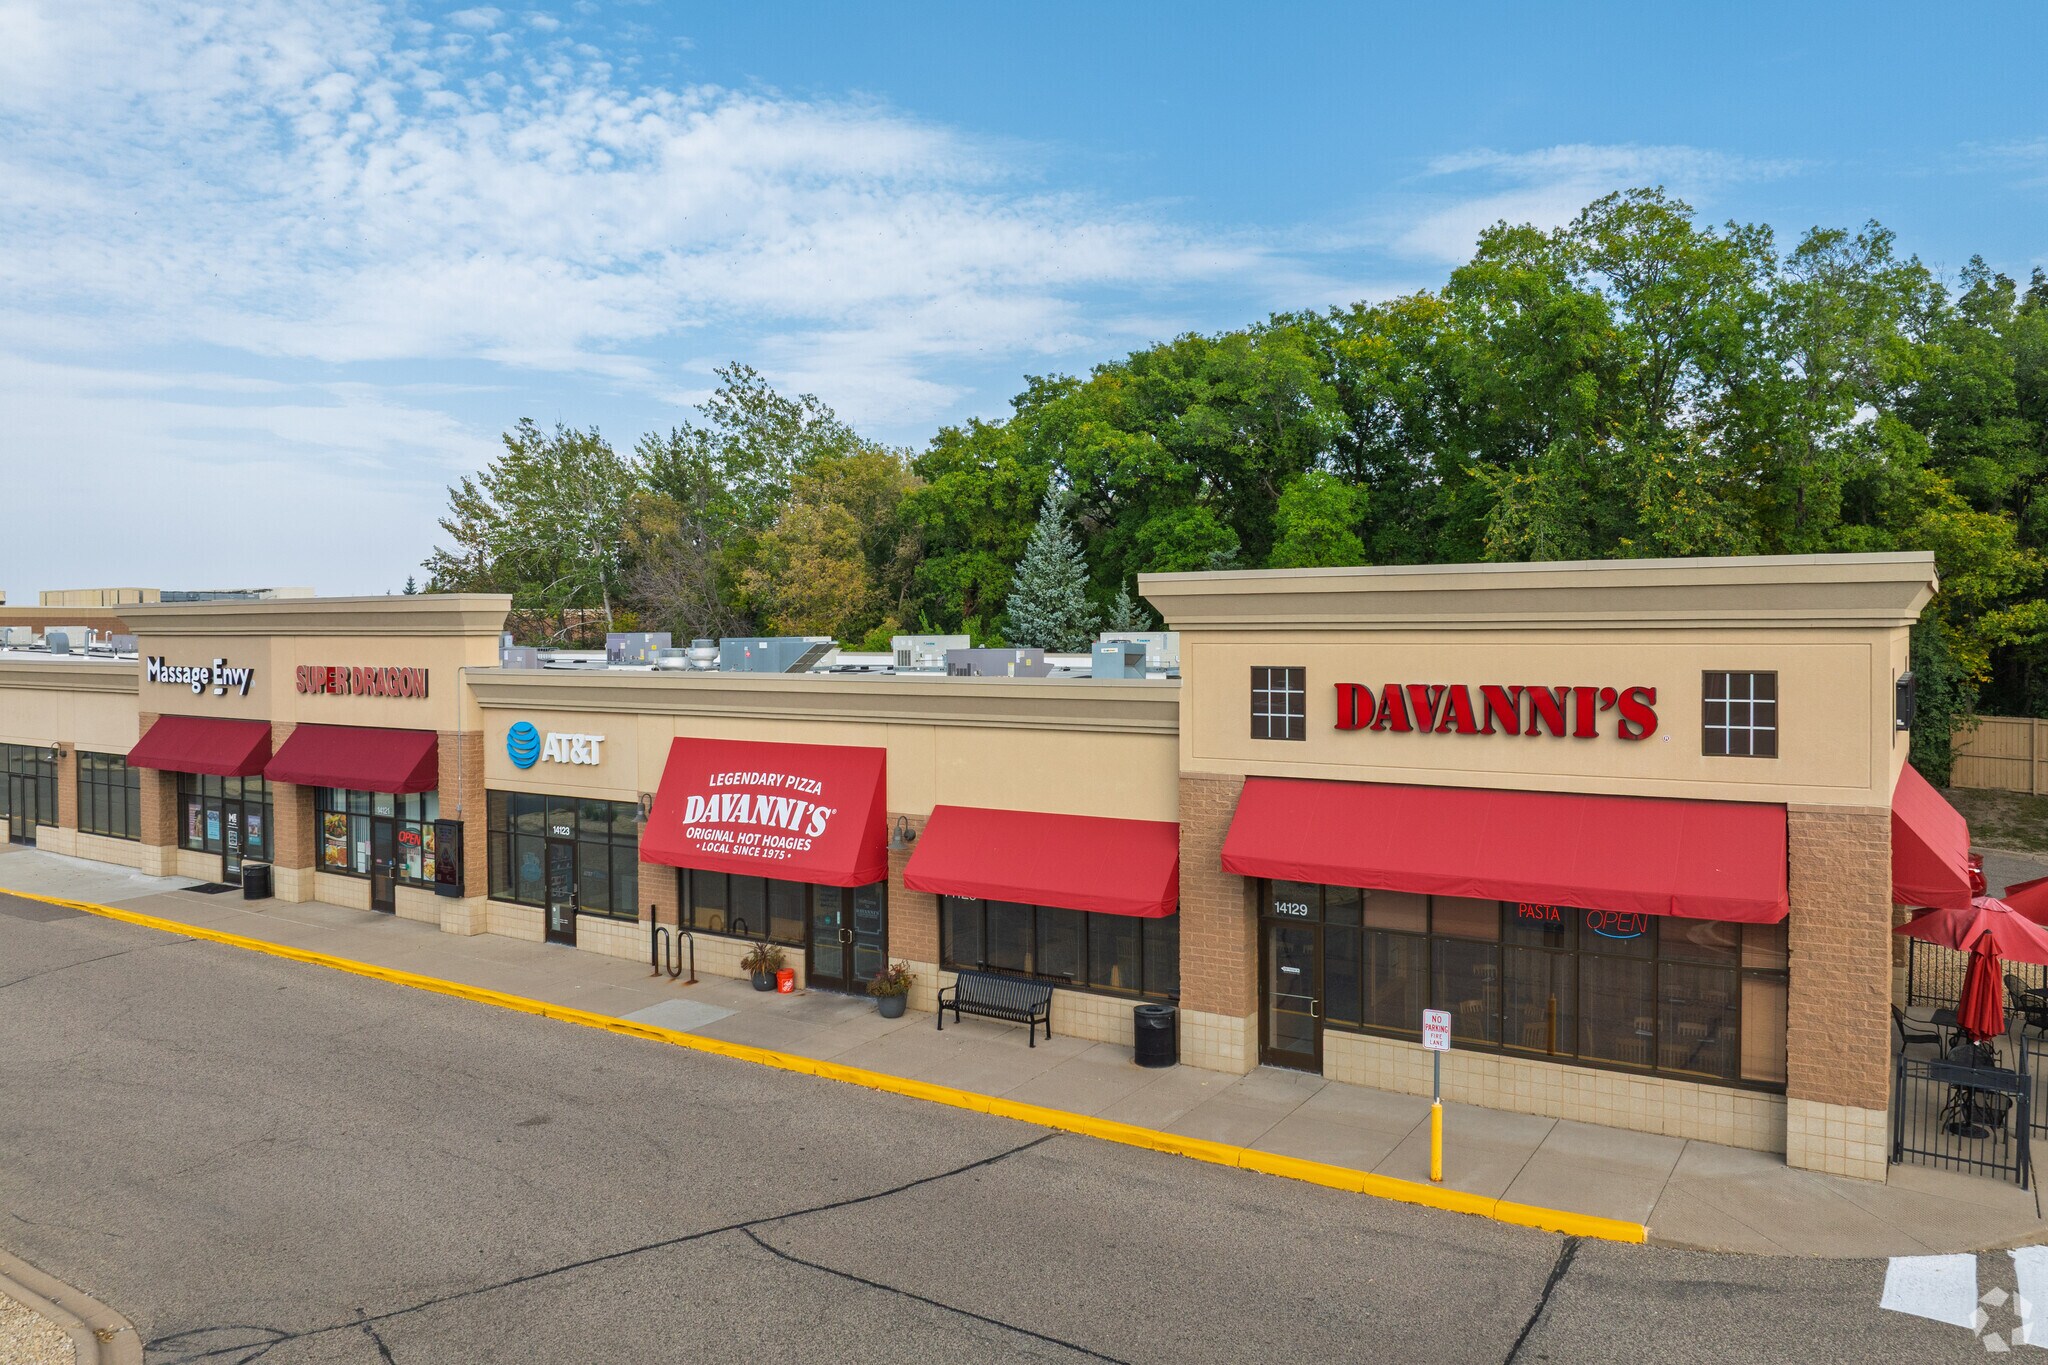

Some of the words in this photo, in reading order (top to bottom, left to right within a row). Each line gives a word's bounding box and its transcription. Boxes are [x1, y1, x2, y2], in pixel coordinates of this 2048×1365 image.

[147, 656, 209, 694] Massage
[213, 658, 253, 696] Envy
[296, 665, 350, 695] SUPER
[352, 666, 428, 698] DRAGON
[1332, 682, 1659, 741] DAVANNI'S
[542, 732, 605, 766] AT&T
[709, 772, 784, 786] LEGENDARY
[786, 776, 822, 796] PIZZA
[398, 830, 421, 846] OPEN
[553, 825, 570, 836] 14123
[686, 827, 735, 843] ORIGINAL
[736, 832, 761, 846] HOT
[762, 834, 812, 851] HOAGIES
[701, 842, 730, 854] LOCAL
[732, 846, 760, 857] SINCE
[761, 848, 785, 860] 1975
[1274, 901, 1308, 917] 14129
[1518, 903, 1561, 922] PASTA
[1586, 909, 1648, 932] OPEN
[1426, 1024, 1448, 1033] PARKING
